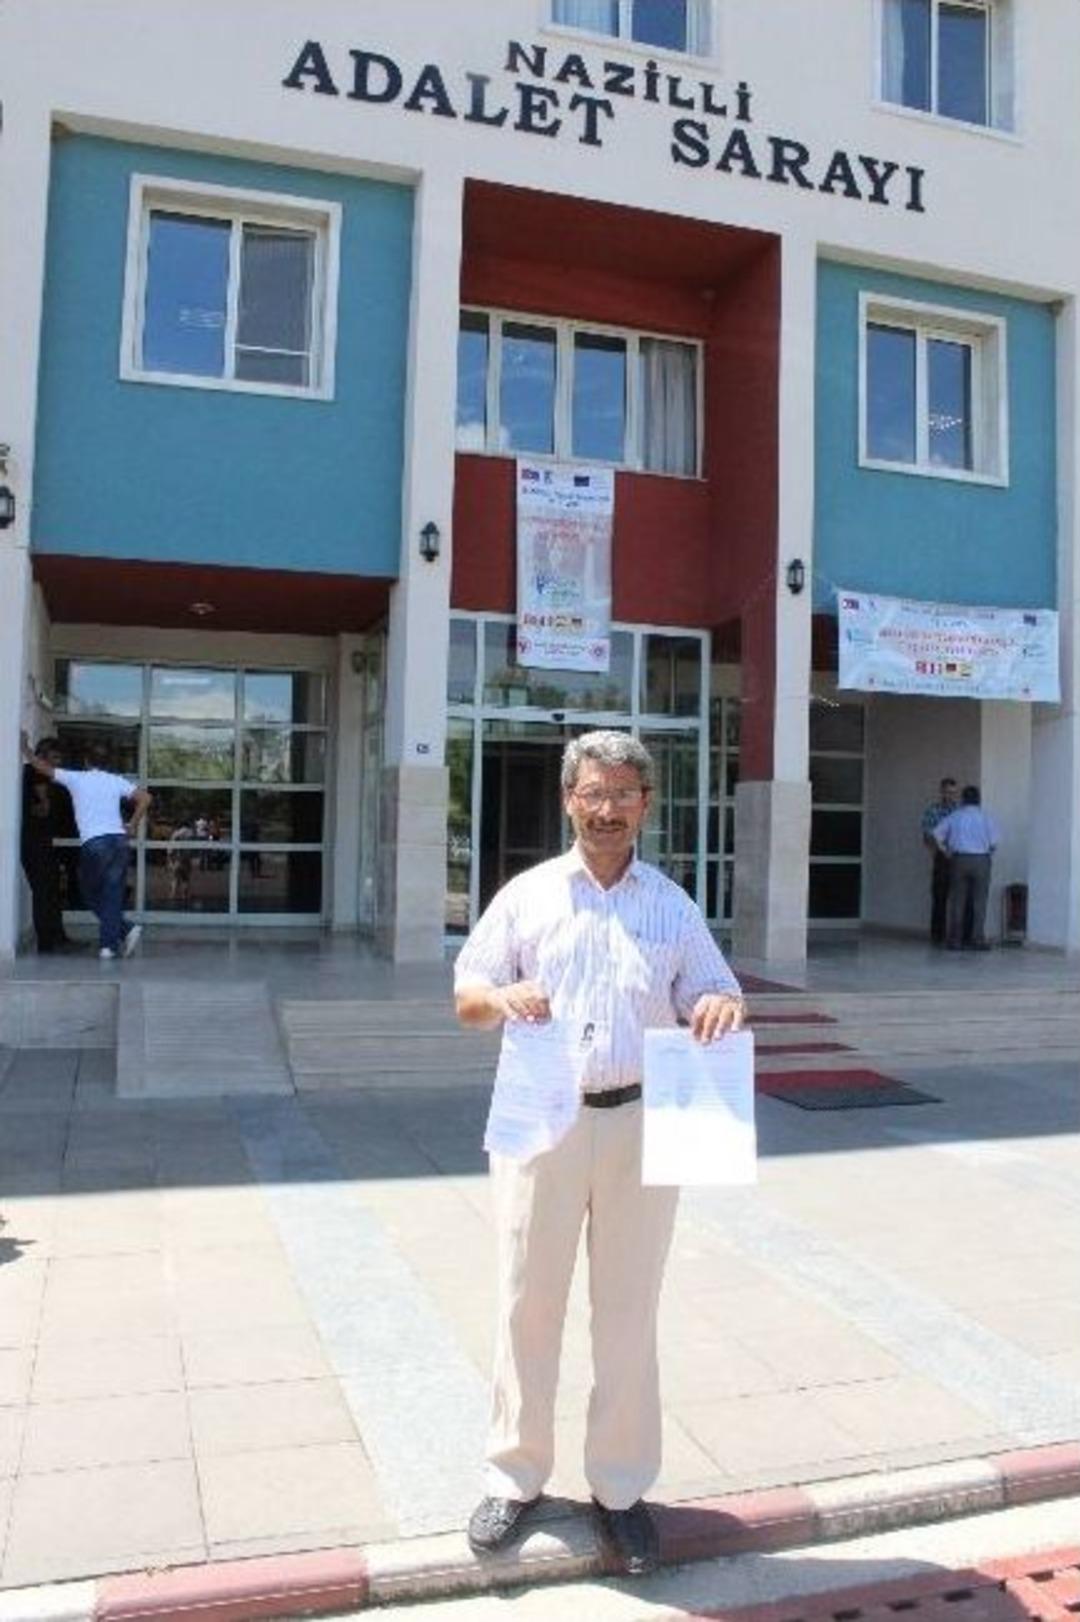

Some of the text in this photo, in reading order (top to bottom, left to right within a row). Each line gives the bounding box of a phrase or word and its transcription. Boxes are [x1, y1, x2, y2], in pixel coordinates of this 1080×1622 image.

[281, 40, 927, 214] ADALET SARAYI
[504, 41, 754, 123] NAZİLLİ
